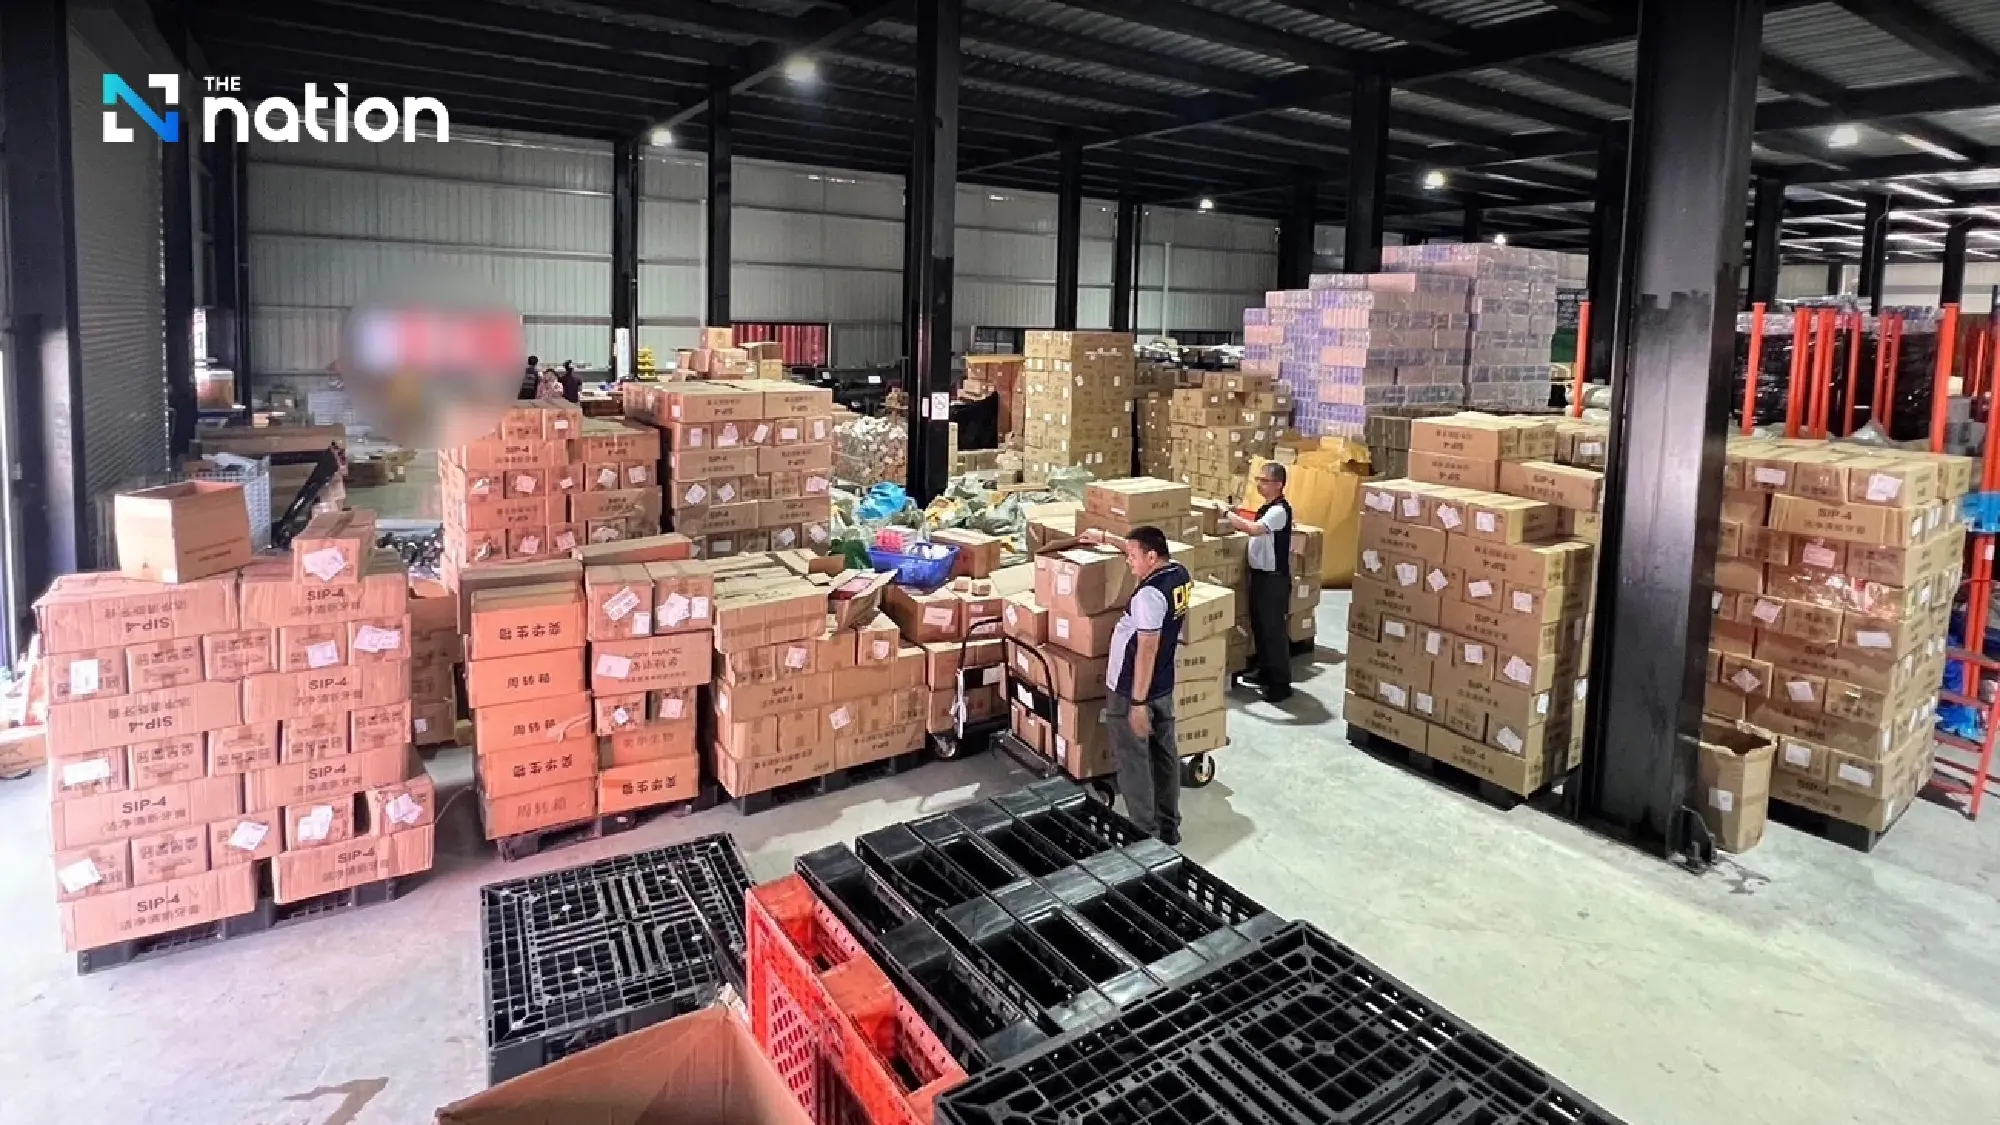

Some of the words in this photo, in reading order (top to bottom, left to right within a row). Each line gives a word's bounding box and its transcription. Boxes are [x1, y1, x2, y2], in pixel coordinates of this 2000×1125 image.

[307, 588, 345, 600] SIP-4
[125, 617, 170, 633] SIP-4
[308, 677, 347, 689] SIP-4
[129, 716, 173, 733] SIP-4
[308, 764, 347, 779] SIP-4
[122, 796, 166, 814] SIP-4
[338, 847, 375, 863] SIP-4
[137, 893, 180, 912] SIP-4
